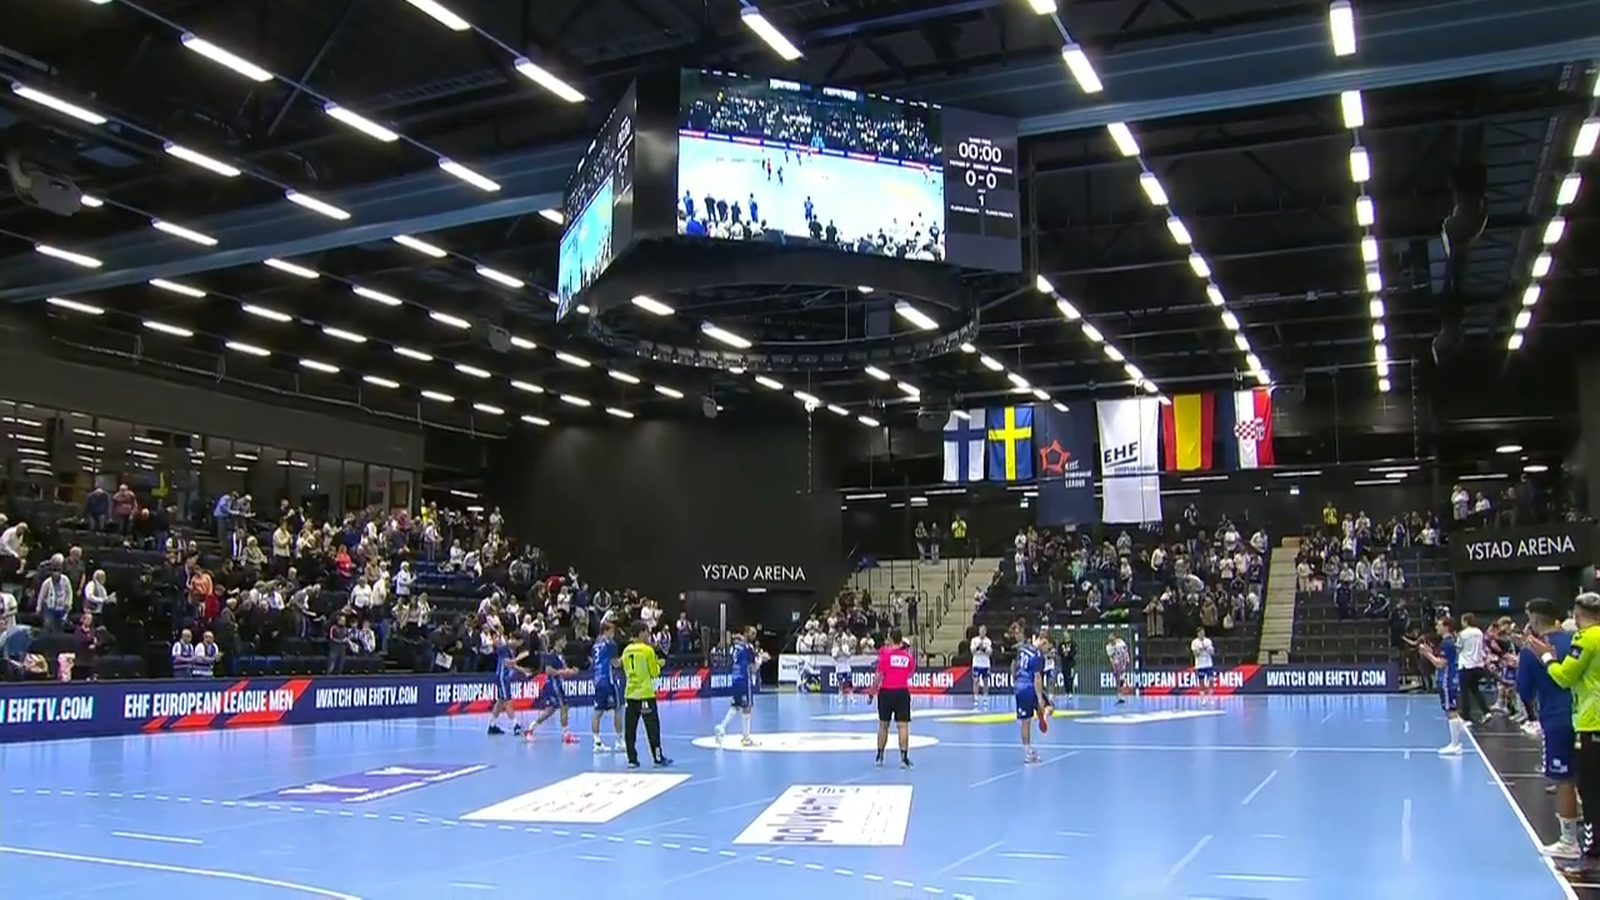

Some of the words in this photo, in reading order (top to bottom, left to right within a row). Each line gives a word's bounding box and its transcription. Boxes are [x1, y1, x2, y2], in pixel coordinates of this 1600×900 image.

[958, 142, 1002, 163] 00:00
[978, 194, 985, 206] 1
[1103, 441, 1138, 464] EHF
[1465, 540, 1513, 560] YSTAD
[1516, 535, 1576, 556] ARENA
[701, 564, 749, 580] YSTAD
[752, 565, 806, 581] ARENA
[629, 654, 635, 670] 1
[932, 672, 954, 687] MEN
[1219, 671, 1243, 687] MEN
[1266, 671, 1306, 686] WATCH
[1307, 671, 1324, 686] ON
[1325, 670, 1386, 686] EHFTV.COM
[124, 693, 150, 718] EHF
[152, 690, 221, 717] EUROPEAN
[223, 689, 267, 714] LEAGUE
[268, 687, 294, 712] MEN
[315, 687, 352, 708] WATCH
[353, 687, 367, 706] ON
[368, 685, 419, 706] EHFTV.COM
[435, 684, 451, 704] EHF
[452, 682, 494, 702] EUROPEAN
[523, 680, 540, 699] MEN
[6, 696, 94, 723] EHFTV.COM
